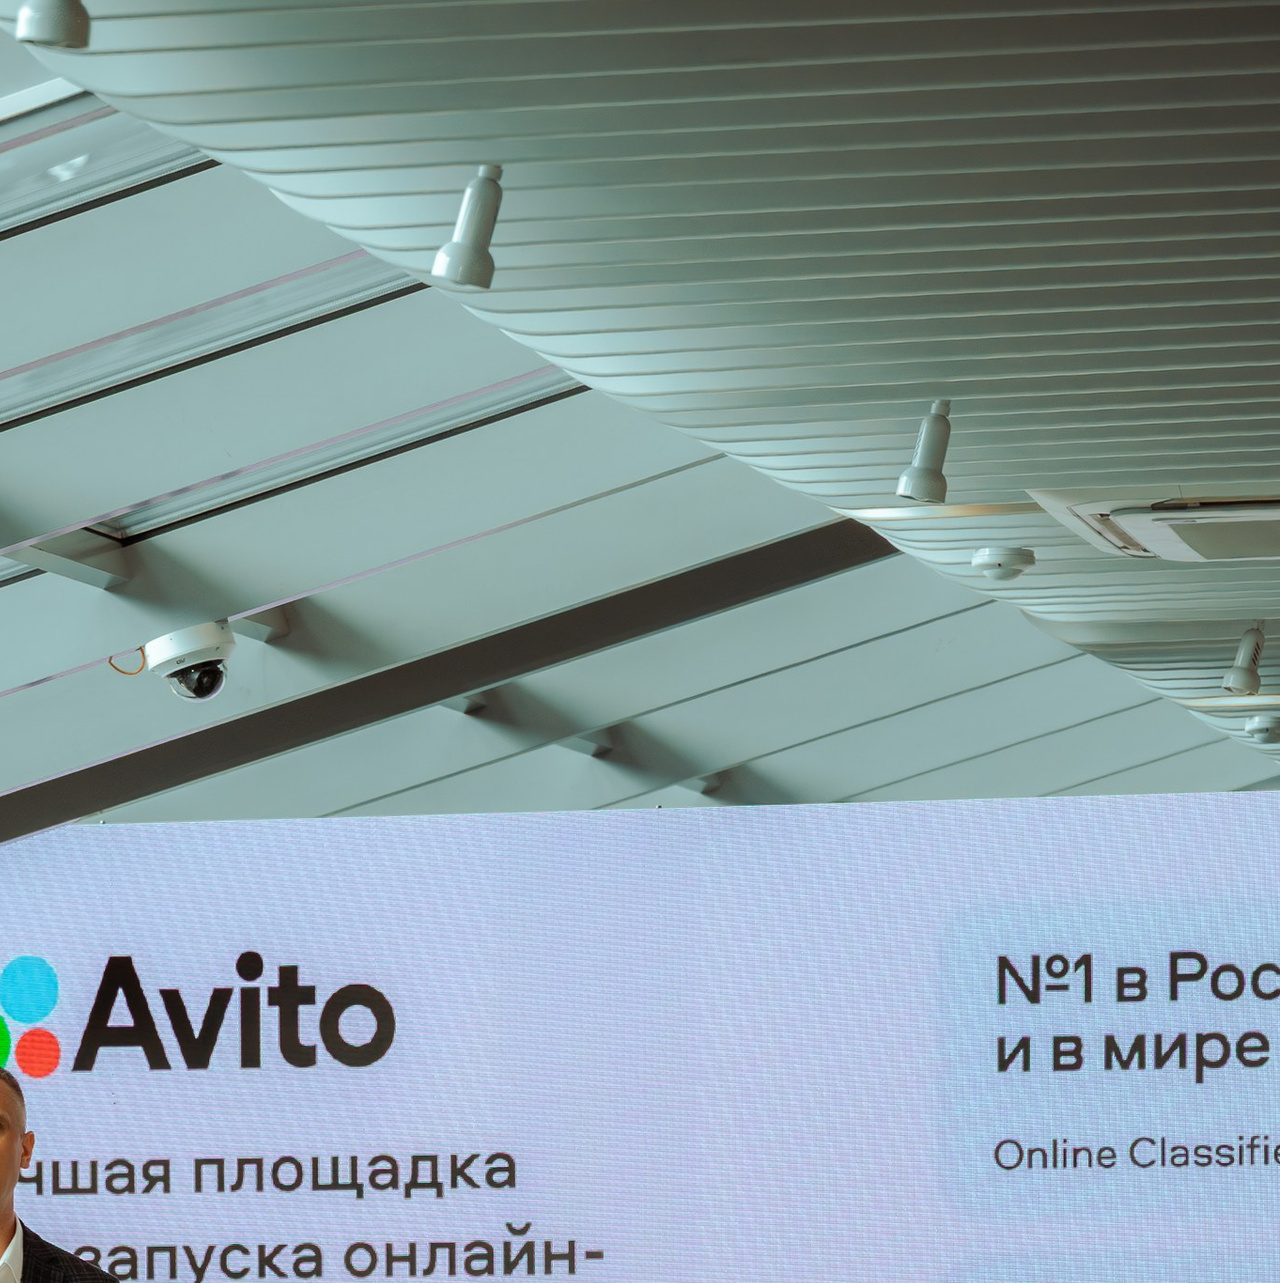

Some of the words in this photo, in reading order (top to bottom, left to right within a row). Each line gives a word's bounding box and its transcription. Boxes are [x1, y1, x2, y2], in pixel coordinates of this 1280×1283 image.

[997, 953, 1092, 1005] №1
[1116, 966, 1148, 1003] в
[1169, 951, 1280, 1002] Рос
[72, 951, 396, 1072] Avito
[997, 1036, 1031, 1073] и
[1052, 1035, 1084, 1072] в
[1104, 1031, 1270, 1084] мире
[194, 1152, 516, 1200] площадка
[994, 1138, 1117, 1171] Online
[343, 1222, 604, 1278] онлайн-
